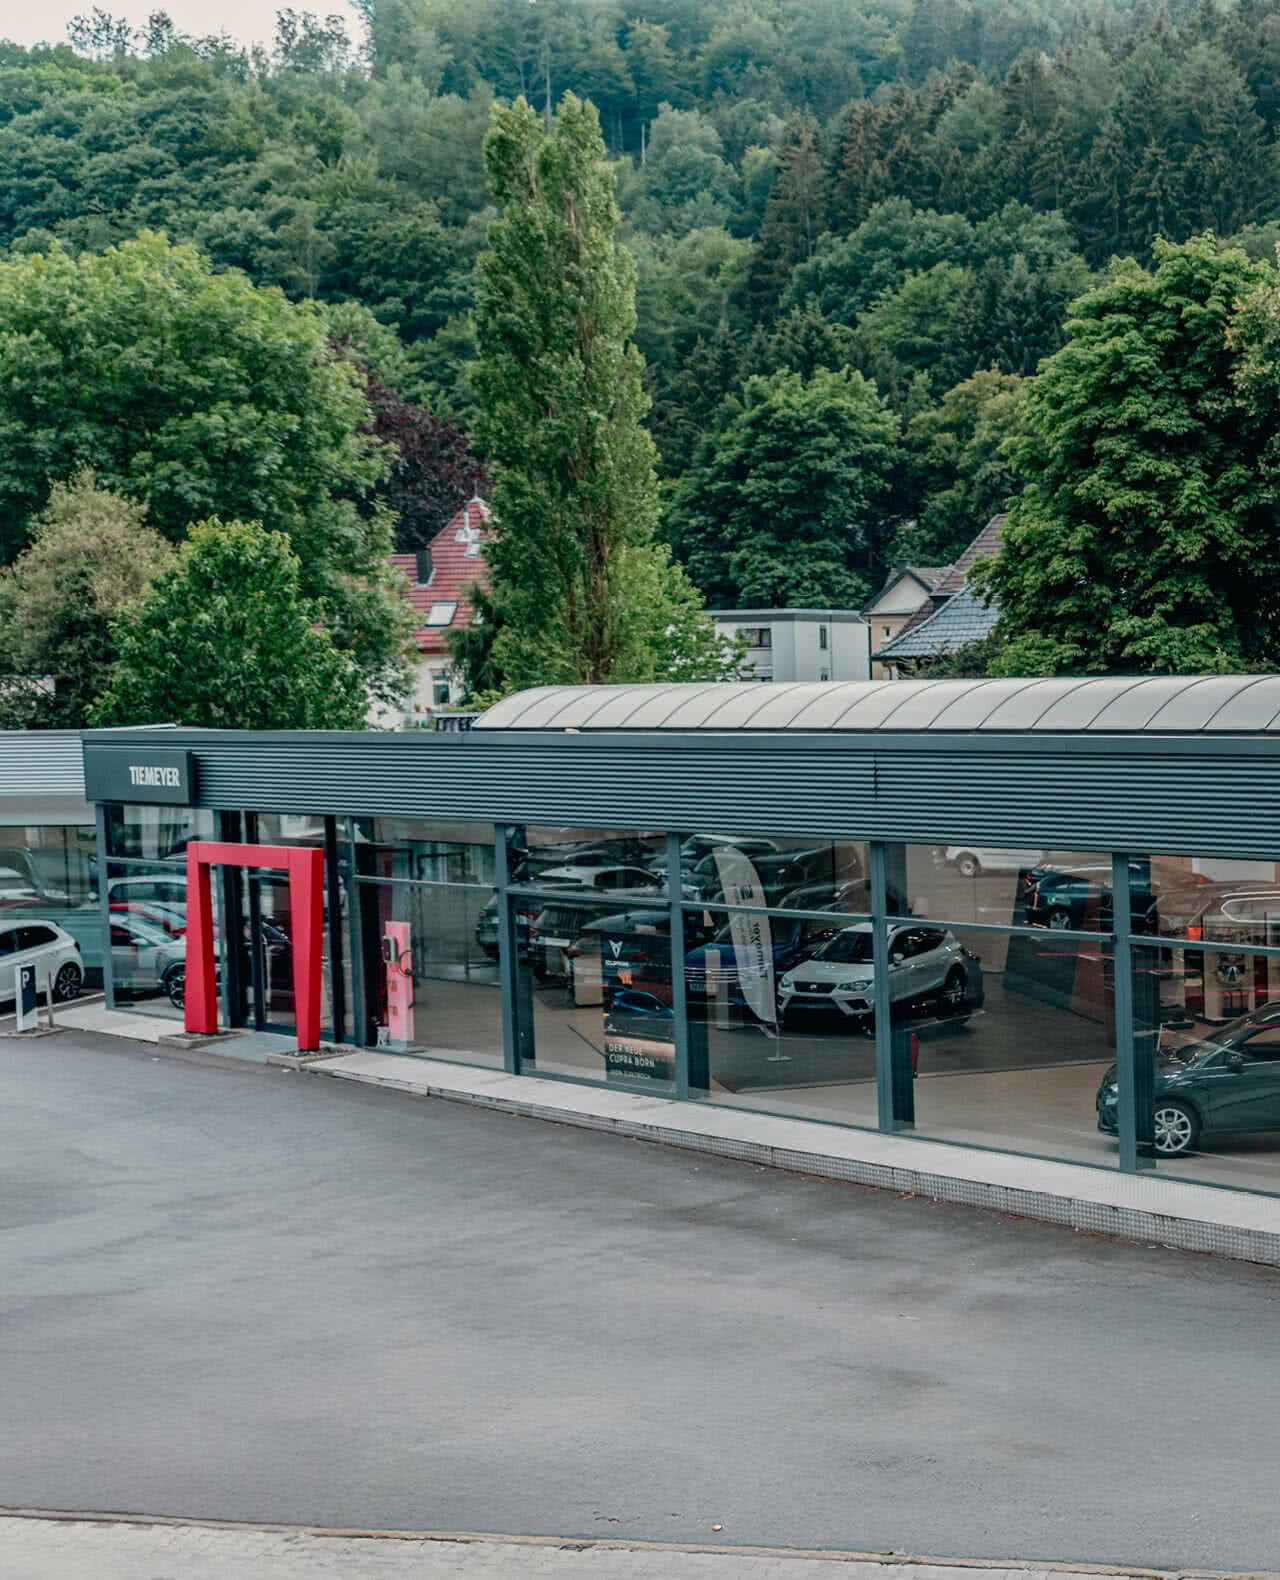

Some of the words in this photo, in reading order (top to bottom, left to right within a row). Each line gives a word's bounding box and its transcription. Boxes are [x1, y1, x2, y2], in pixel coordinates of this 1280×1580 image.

[129, 766, 180, 786] TIEMEYER
[22, 970, 30, 990] P
[609, 1053, 633, 1065] CUPRA
[634, 1056, 655, 1068] BORN
